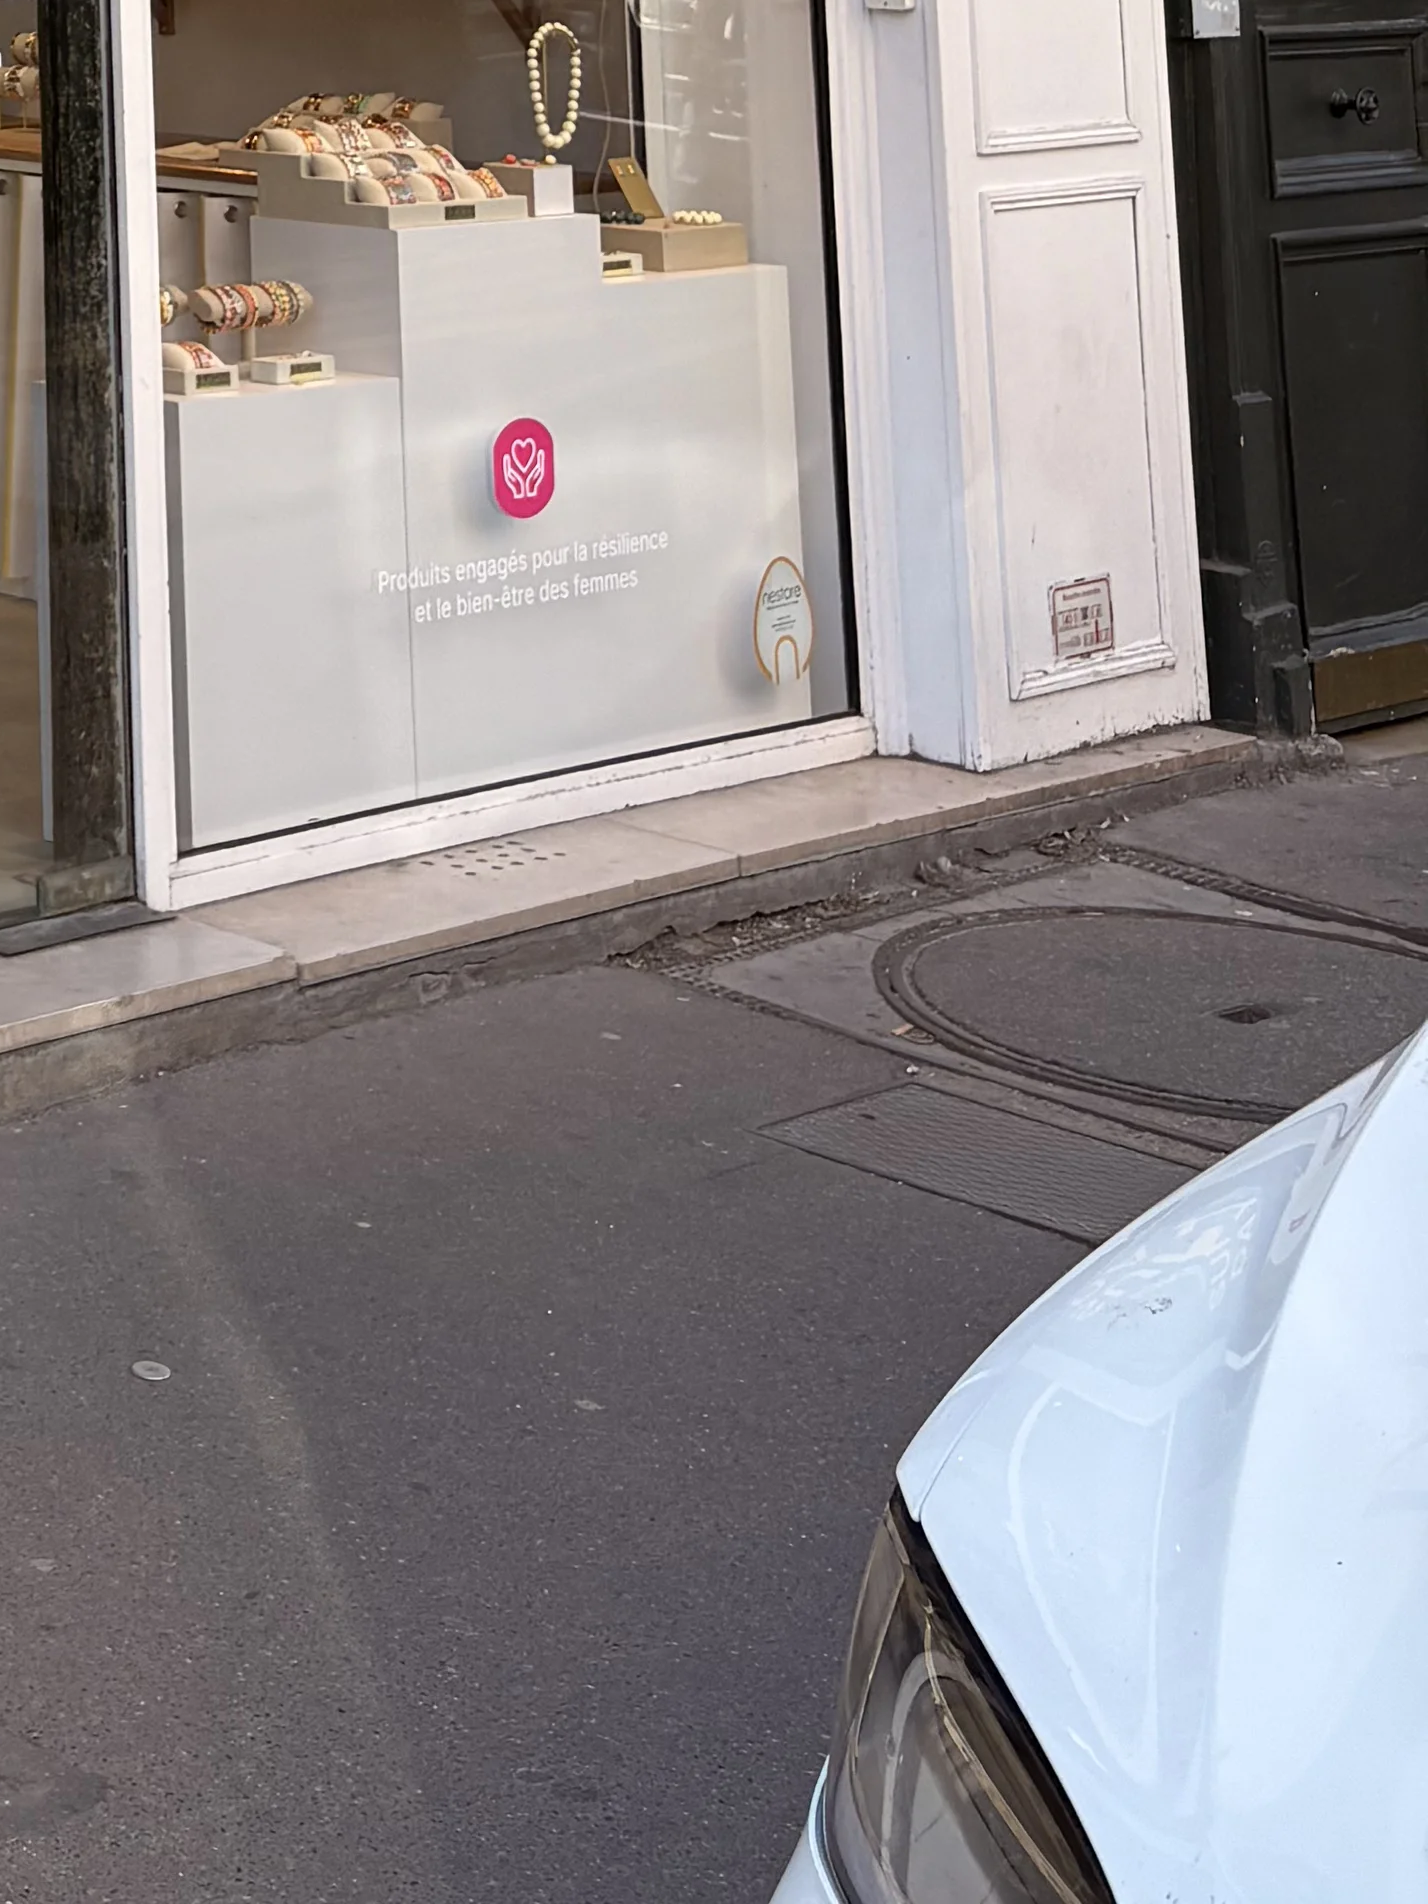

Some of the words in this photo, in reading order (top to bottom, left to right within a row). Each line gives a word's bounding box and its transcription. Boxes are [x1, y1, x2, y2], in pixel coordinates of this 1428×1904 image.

[378, 565, 451, 594] Produits
[455, 550, 528, 584] engagés
[532, 545, 569, 575] pour
[574, 540, 588, 563] la
[592, 529, 669, 560] résilience
[414, 601, 432, 623] et
[436, 597, 452, 620] le
[456, 584, 535, 616] bien-être
[539, 578, 569, 603] des
[574, 567, 638, 598] femmes
